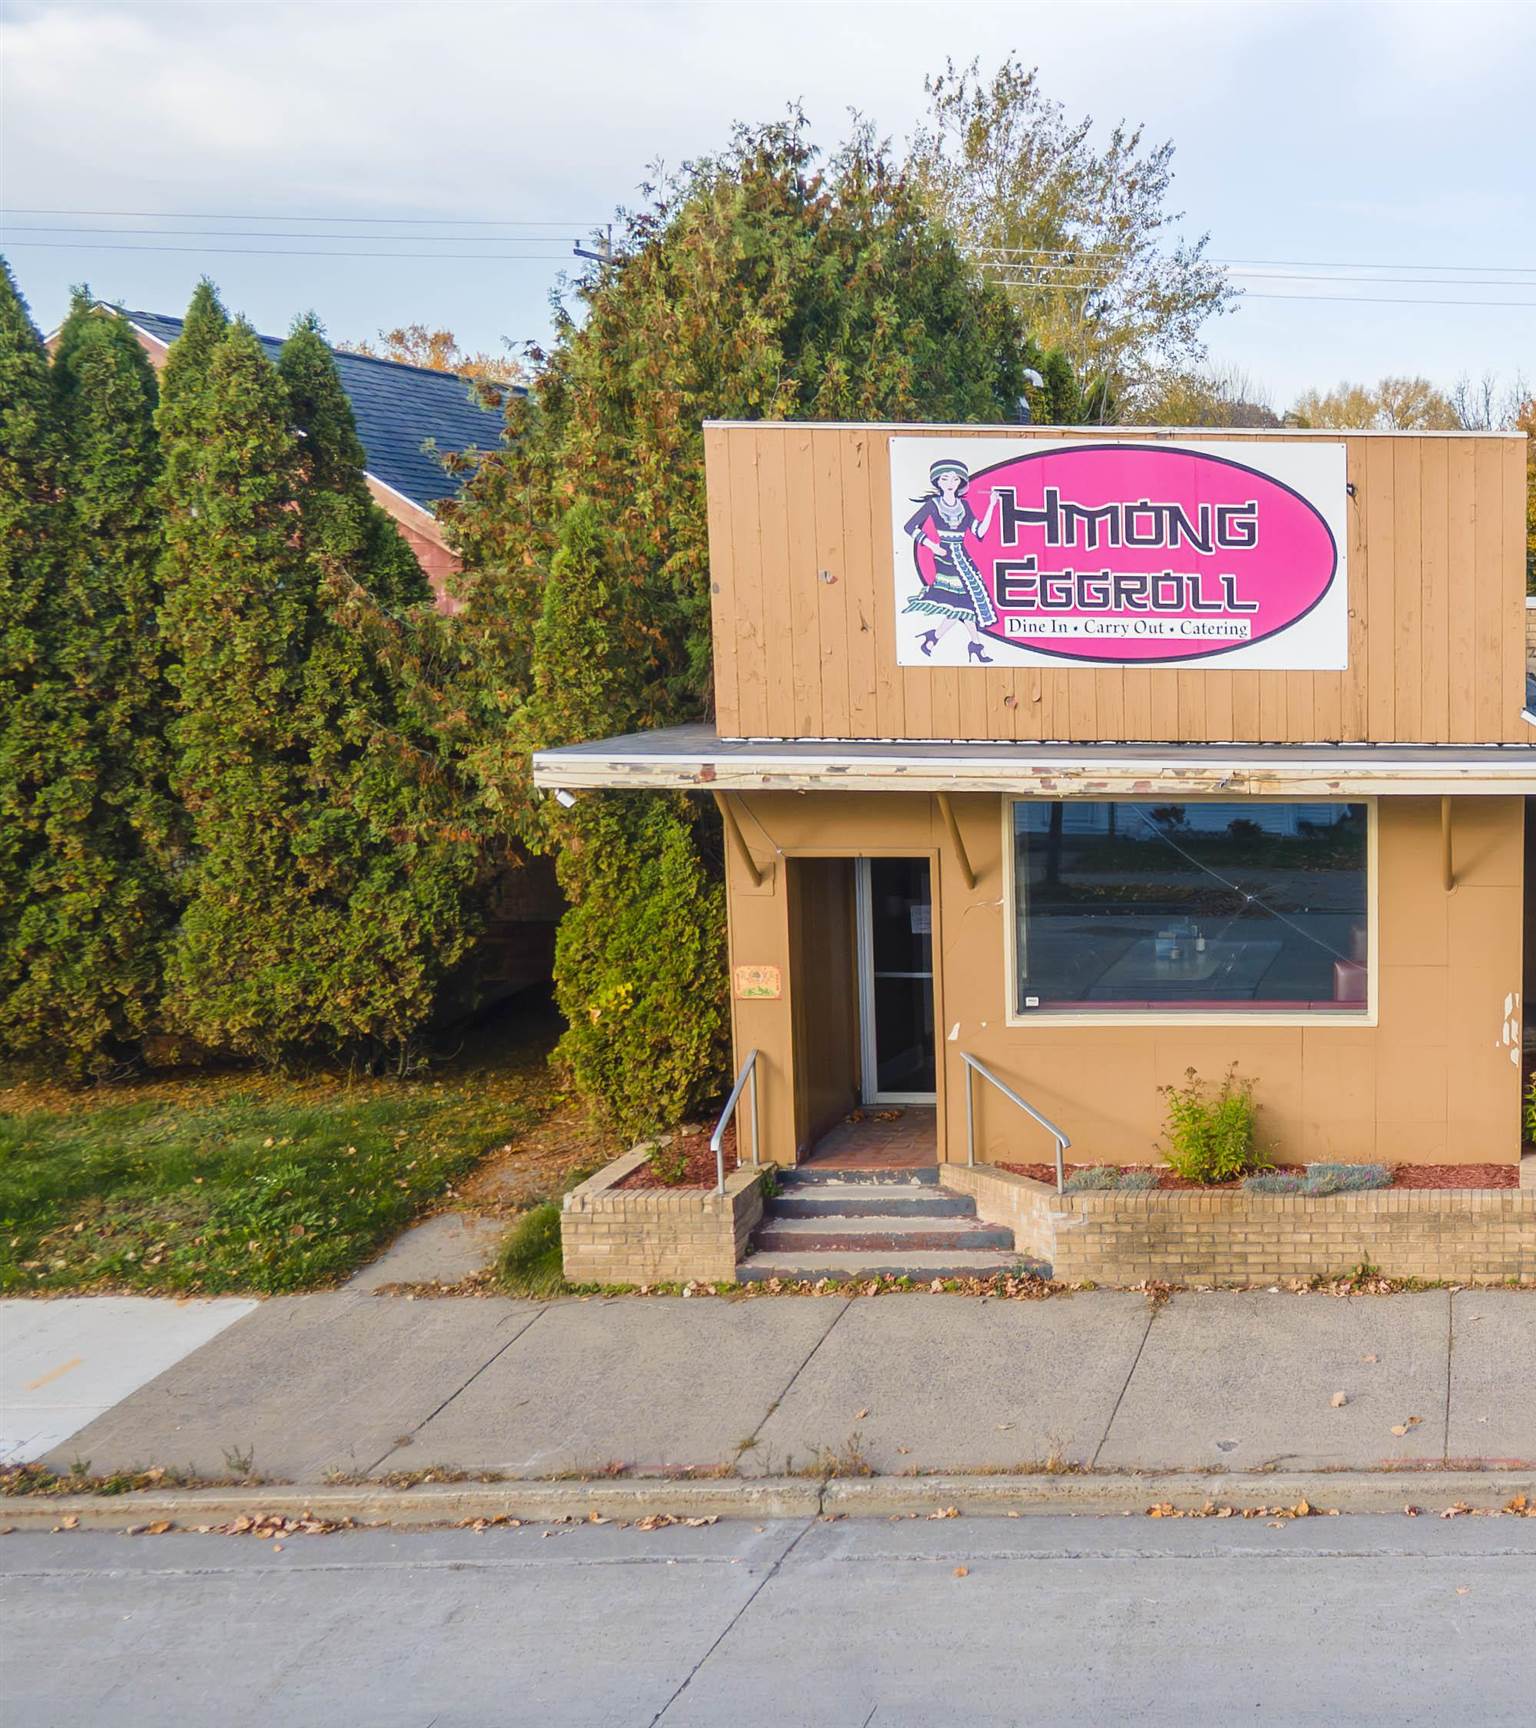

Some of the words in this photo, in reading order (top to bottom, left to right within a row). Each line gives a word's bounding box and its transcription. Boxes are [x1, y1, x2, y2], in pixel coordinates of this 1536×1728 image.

[996, 558, 1257, 610] EGGROLL
[1009, 618, 1045, 633] Dine
[1051, 619, 1067, 633] In
[1084, 620, 1129, 637] Carry
[1134, 620, 1164, 634] Out
[1180, 620, 1248, 638] Catering
